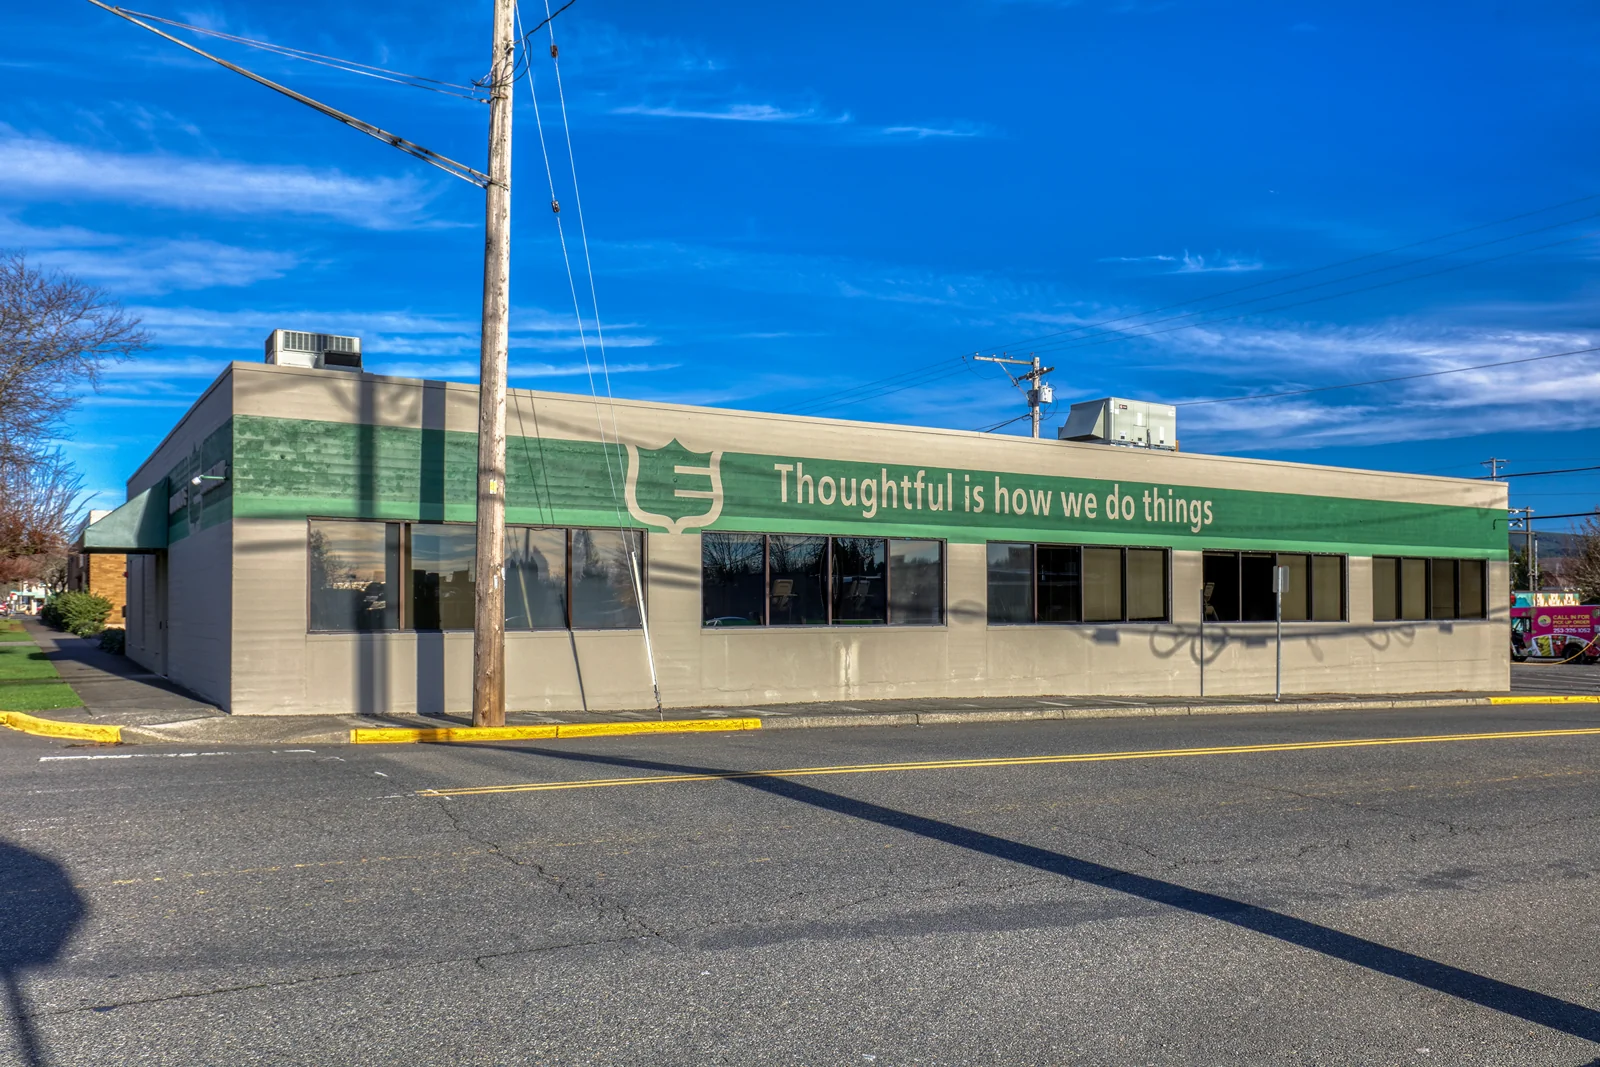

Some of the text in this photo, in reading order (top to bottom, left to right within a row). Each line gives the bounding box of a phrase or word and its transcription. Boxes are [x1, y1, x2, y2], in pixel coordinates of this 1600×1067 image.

[774, 462, 1213, 533] Thoughtful is how we do things
